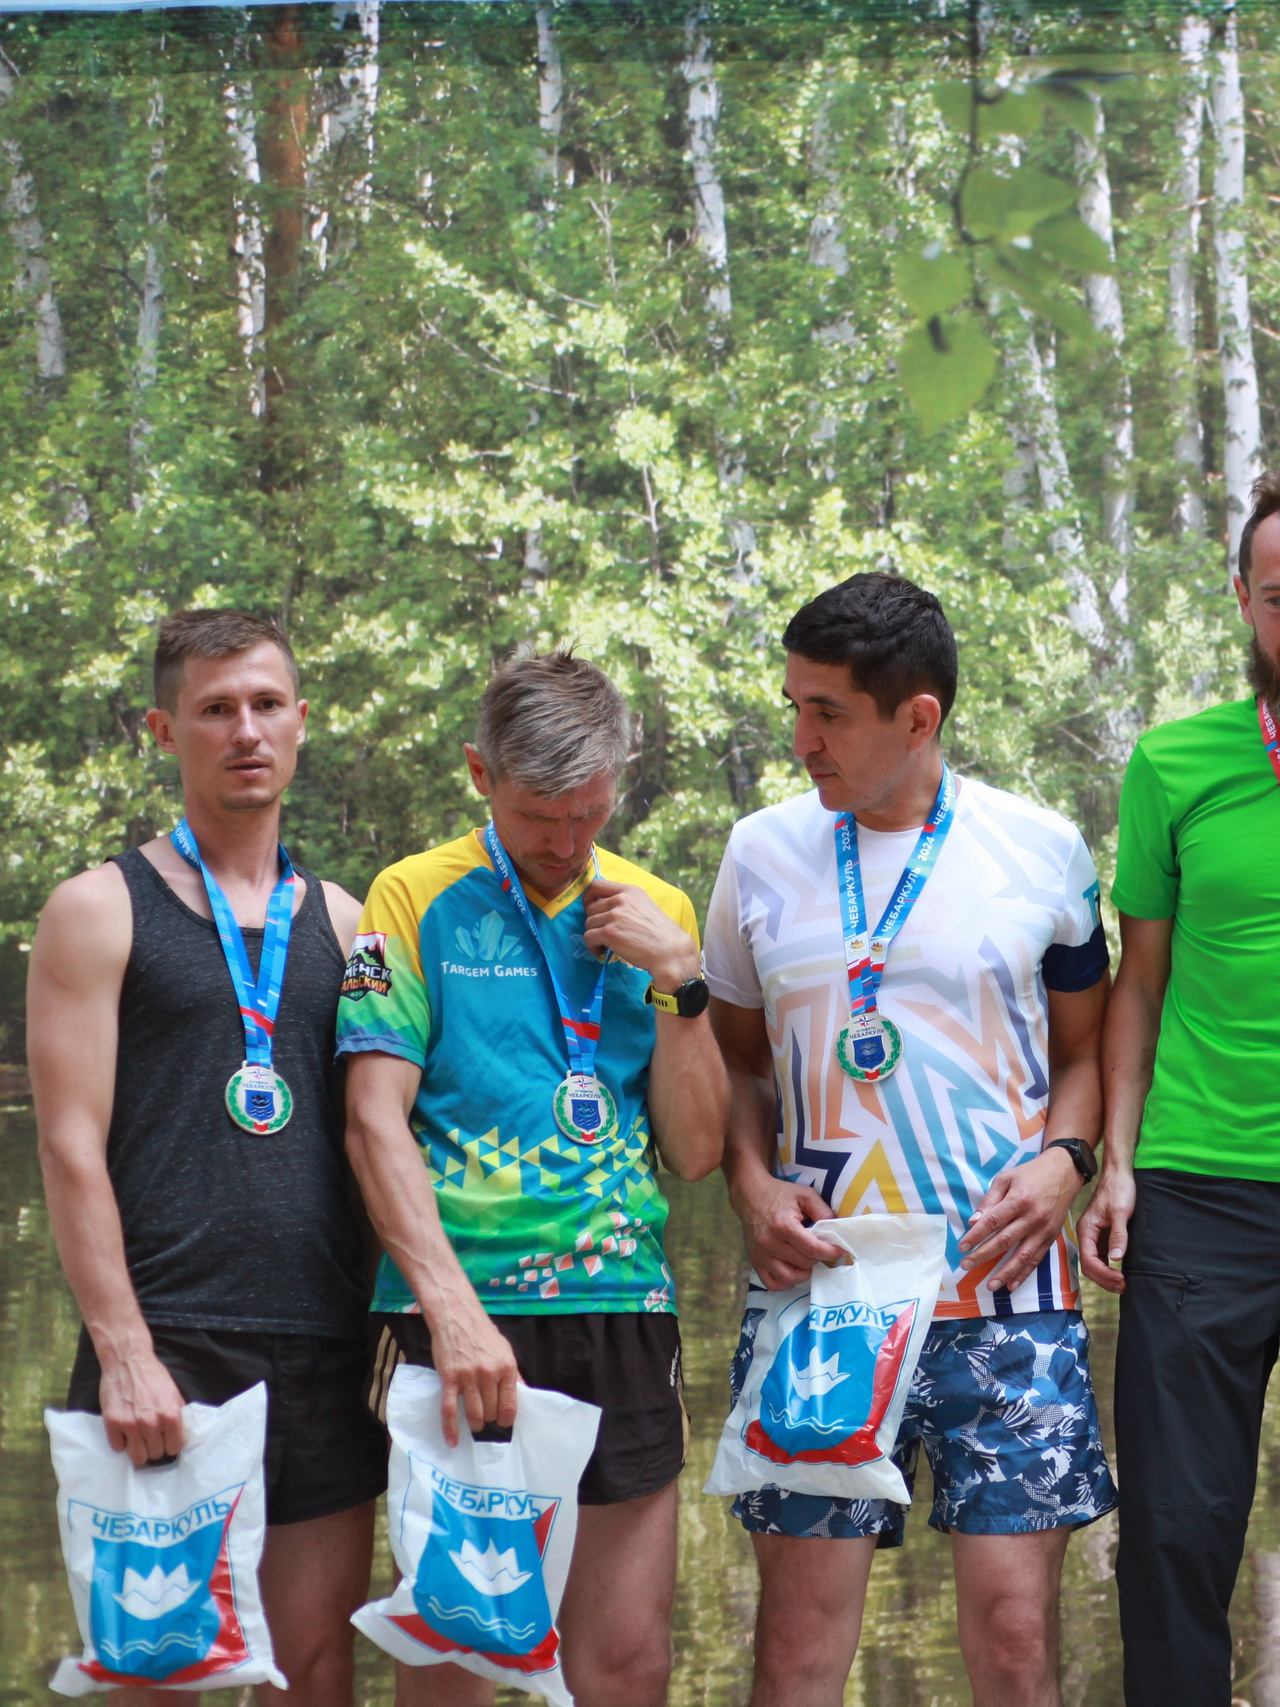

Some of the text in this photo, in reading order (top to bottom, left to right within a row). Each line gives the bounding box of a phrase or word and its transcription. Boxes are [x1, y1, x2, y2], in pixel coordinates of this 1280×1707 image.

[842, 824, 860, 929] ЧЕБАРКУЛЬ 2024
[881, 867, 921, 933] ЧЕБАРКУЛЬ
[917, 836, 936, 862] 2024
[510, 886, 527, 914] 2024
[441, 961, 538, 977] TARGEM GAMES
[91, 1499, 231, 1542] ЧЕБАРКУЛЬ
